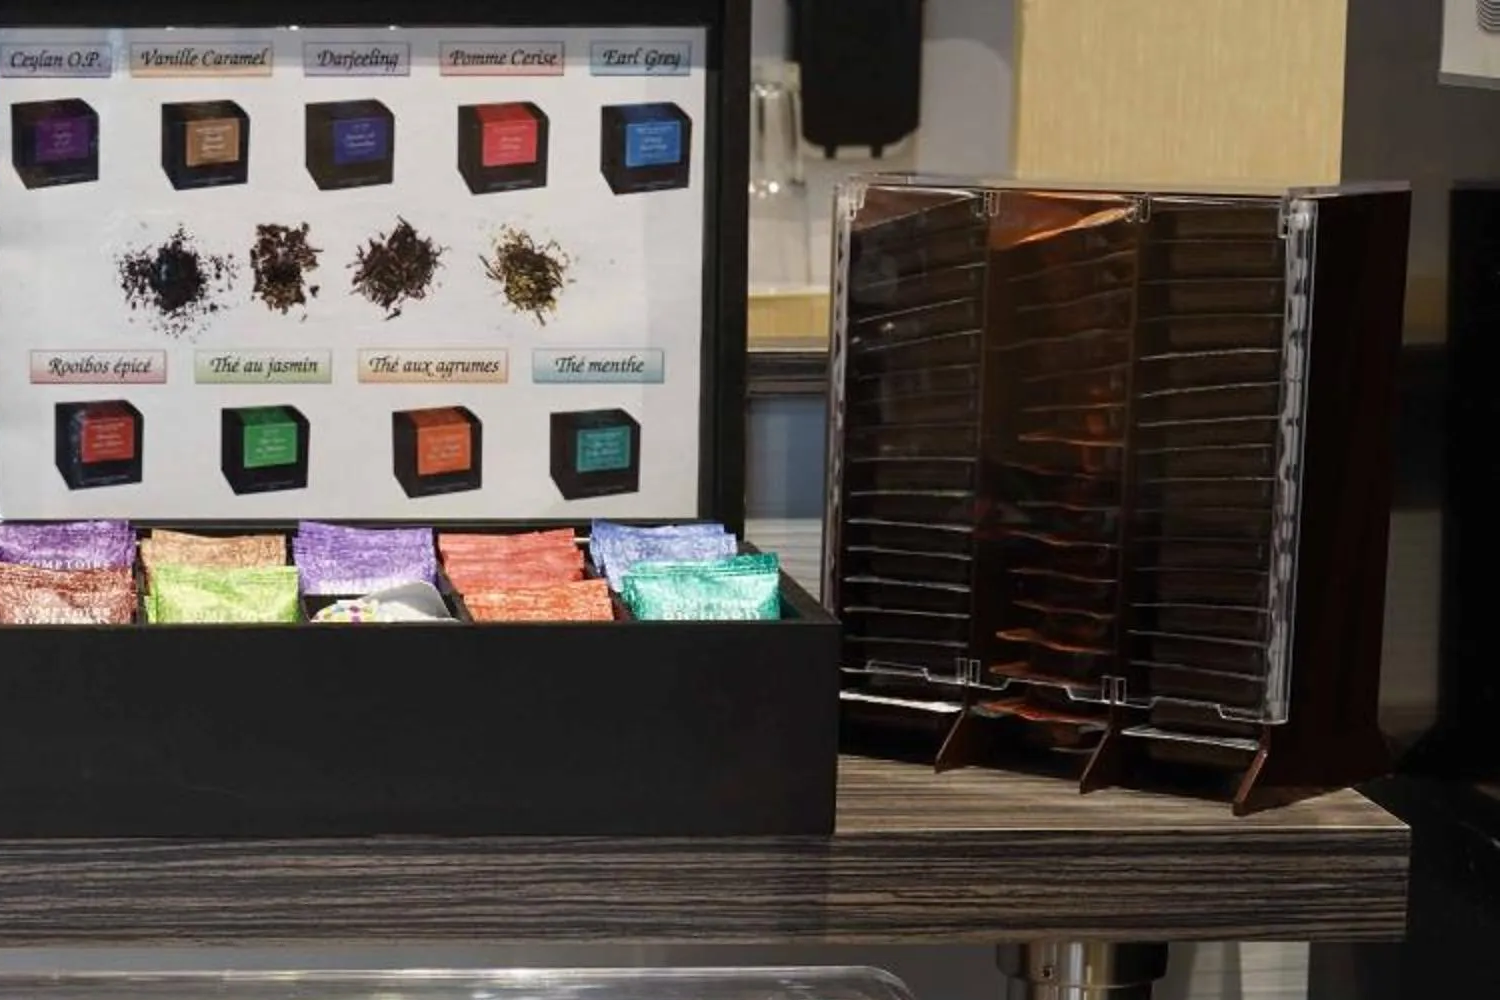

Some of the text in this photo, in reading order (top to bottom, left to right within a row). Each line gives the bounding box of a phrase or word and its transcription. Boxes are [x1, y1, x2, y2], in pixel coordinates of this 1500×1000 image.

[10, 50, 63, 72] Ceylan
[141, 48, 269, 68] Vanille Caramel
[316, 49, 400, 70] Darjeeling
[449, 49, 558, 67] Pomme Cerise
[602, 48, 682, 70] Earl Grey
[47, 356, 152, 379] Rooibos épicé
[209, 356, 319, 379] Thé au jasmin
[368, 356, 500, 379] Thé aux agrumes
[555, 356, 645, 374] Thé menthe
